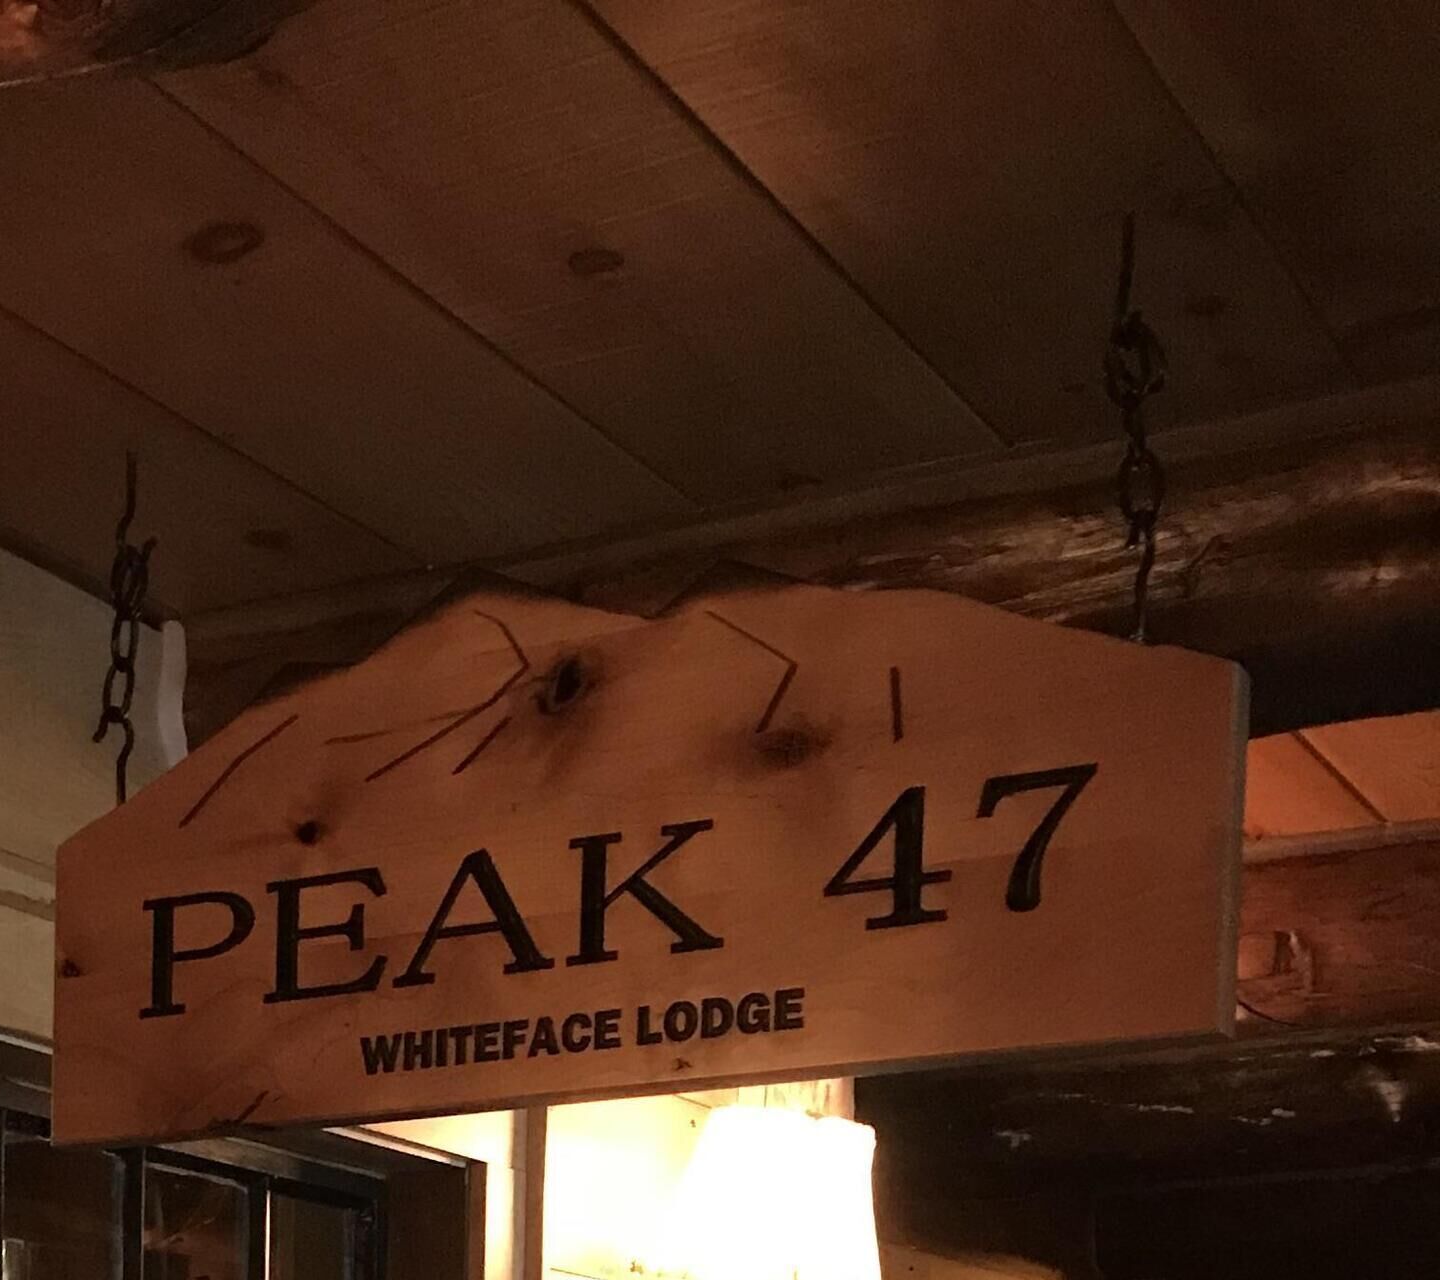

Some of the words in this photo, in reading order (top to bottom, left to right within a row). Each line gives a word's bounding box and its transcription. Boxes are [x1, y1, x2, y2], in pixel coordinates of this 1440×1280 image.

[140, 820, 724, 1018] PEAK
[823, 762, 1098, 932] 47
[361, 1010, 621, 1075] WHITEFACE
[636, 988, 806, 1047] LODGE
